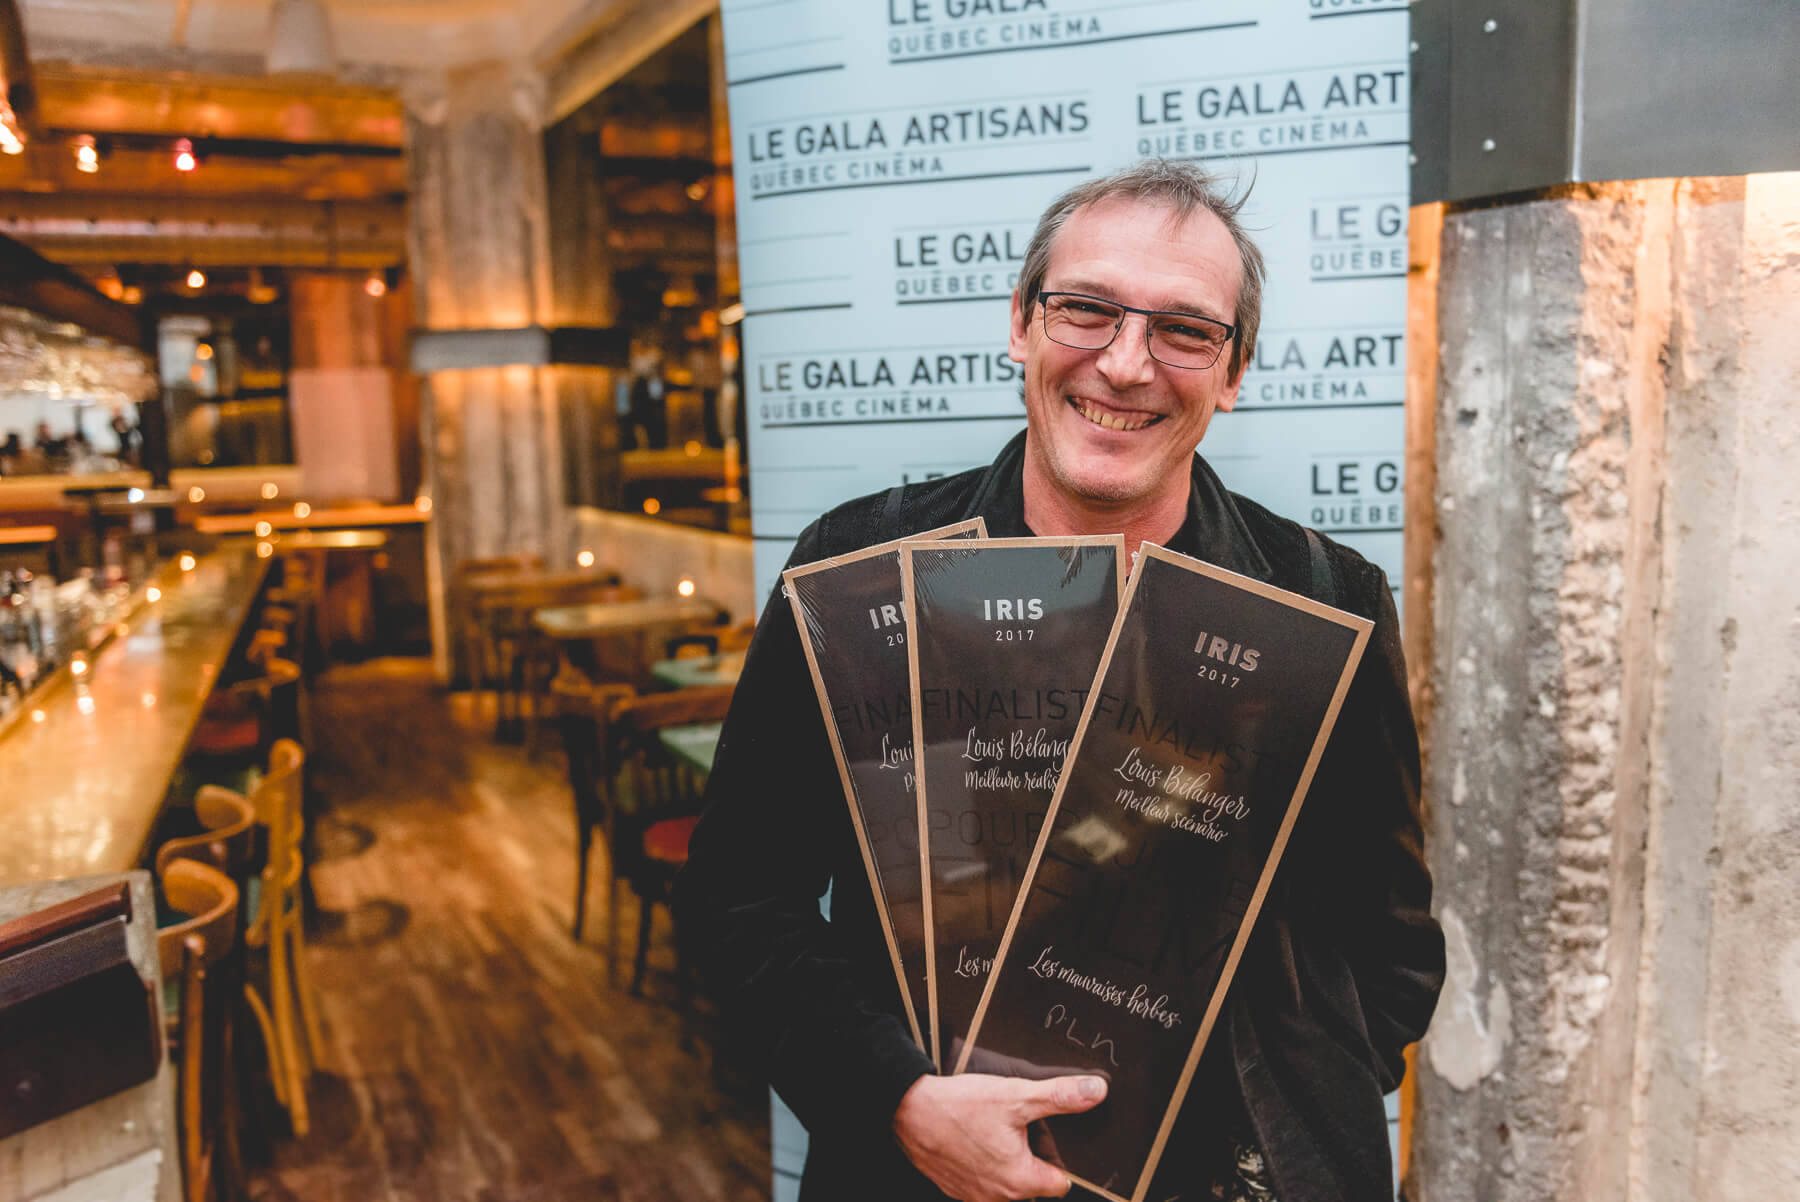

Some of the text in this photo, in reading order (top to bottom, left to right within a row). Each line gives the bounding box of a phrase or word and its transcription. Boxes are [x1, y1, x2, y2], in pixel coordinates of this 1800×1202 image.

[1137, 90, 1183, 125] LE
[1198, 78, 1305, 119] GALA
[749, 101, 1089, 162] LE GALA ARTISANS
[1310, 206, 1361, 241] LE
[895, 231, 1026, 268] LE GAL
[759, 352, 1026, 393] LE GALA ARTIS
[1311, 464, 1359, 495] LE
[984, 598, 1044, 621] IRIS
[885, 633, 905, 647] 20
[995, 628, 1035, 641] 2017
[1194, 631, 1261, 672] IRIS
[1197, 664, 1240, 689] 2017
[921, 688, 1090, 720] FINALIST
[879, 732, 914, 770] Loui
[961, 726, 1073, 773] Louis Bélang
[1092, 691, 1274, 775] FINALIST
[964, 766, 1022, 792] Meilleure
[1113, 746, 1251, 823] Louis Bélanger
[1114, 788, 1171, 823] Meilleur
[1171, 812, 1229, 843] scénario
[954, 945, 981, 978] Les
[1027, 945, 1060, 978] Les
[1057, 967, 1126, 1006] mauvaises
[1126, 984, 1182, 1029] herbes
